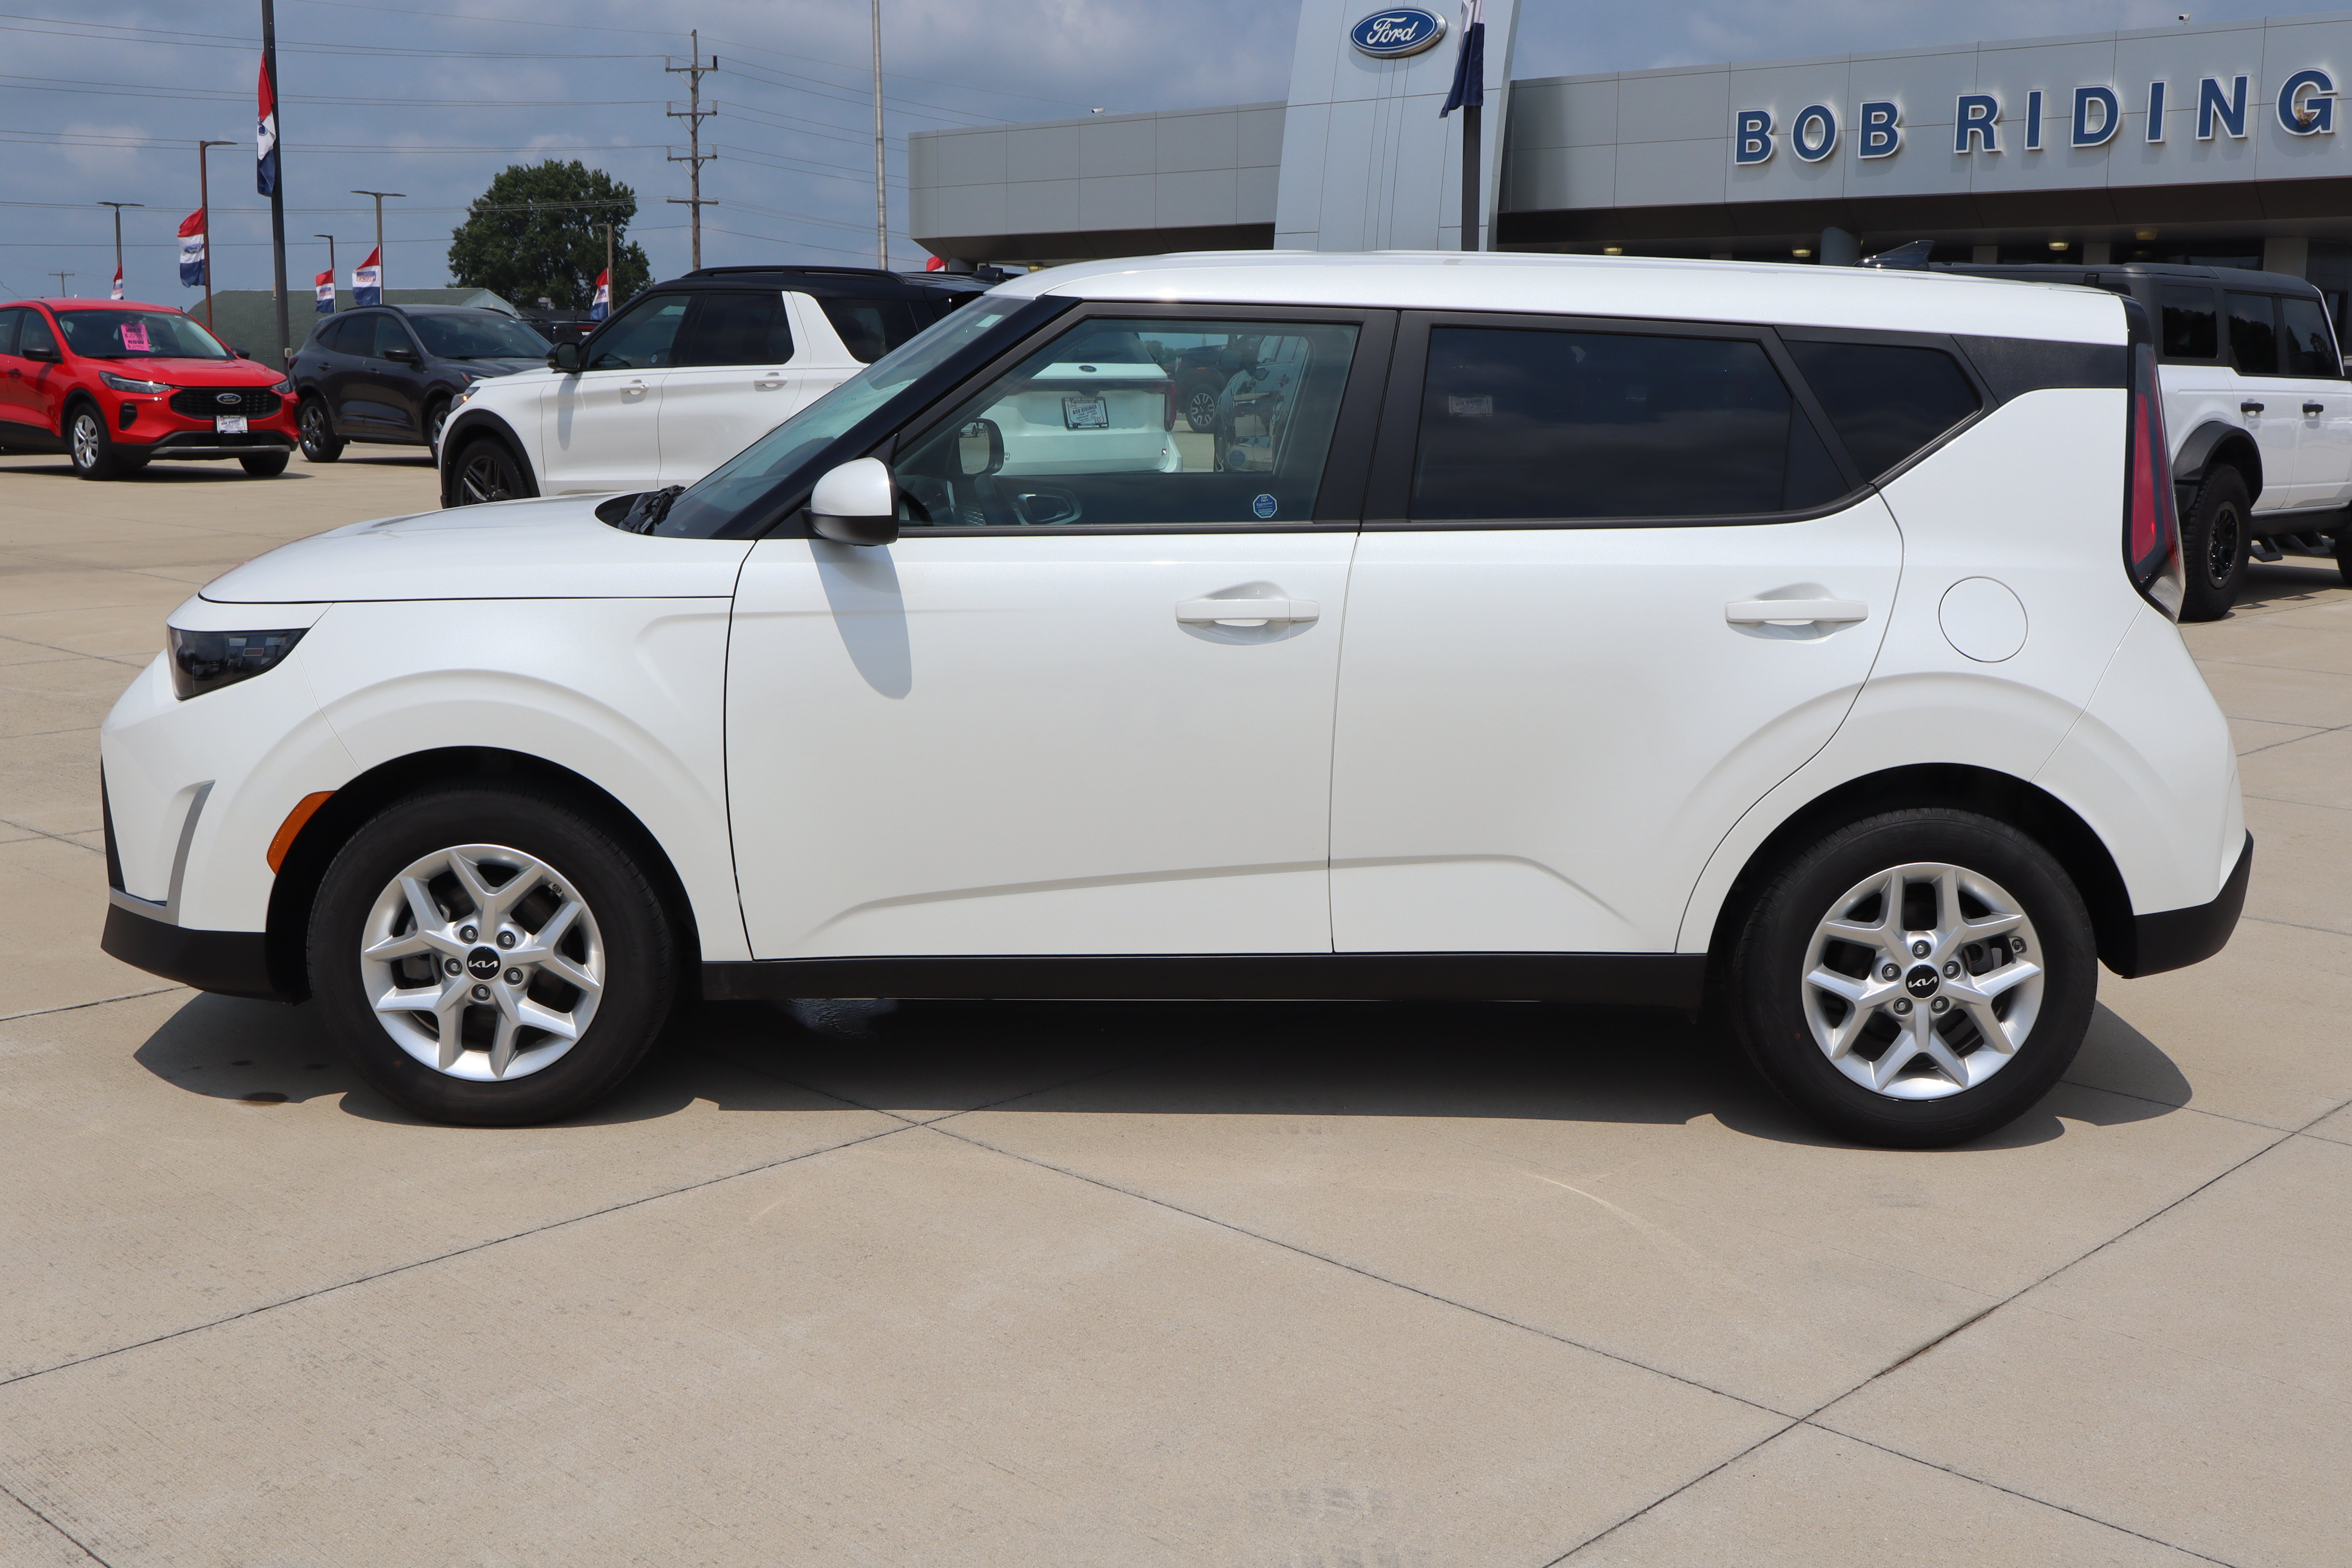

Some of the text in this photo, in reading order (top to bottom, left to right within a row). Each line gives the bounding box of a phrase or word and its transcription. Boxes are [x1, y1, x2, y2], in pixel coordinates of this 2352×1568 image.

[1366, 17, 1419, 45] Ford
[1734, 68, 2337, 165] BOB RIDING
